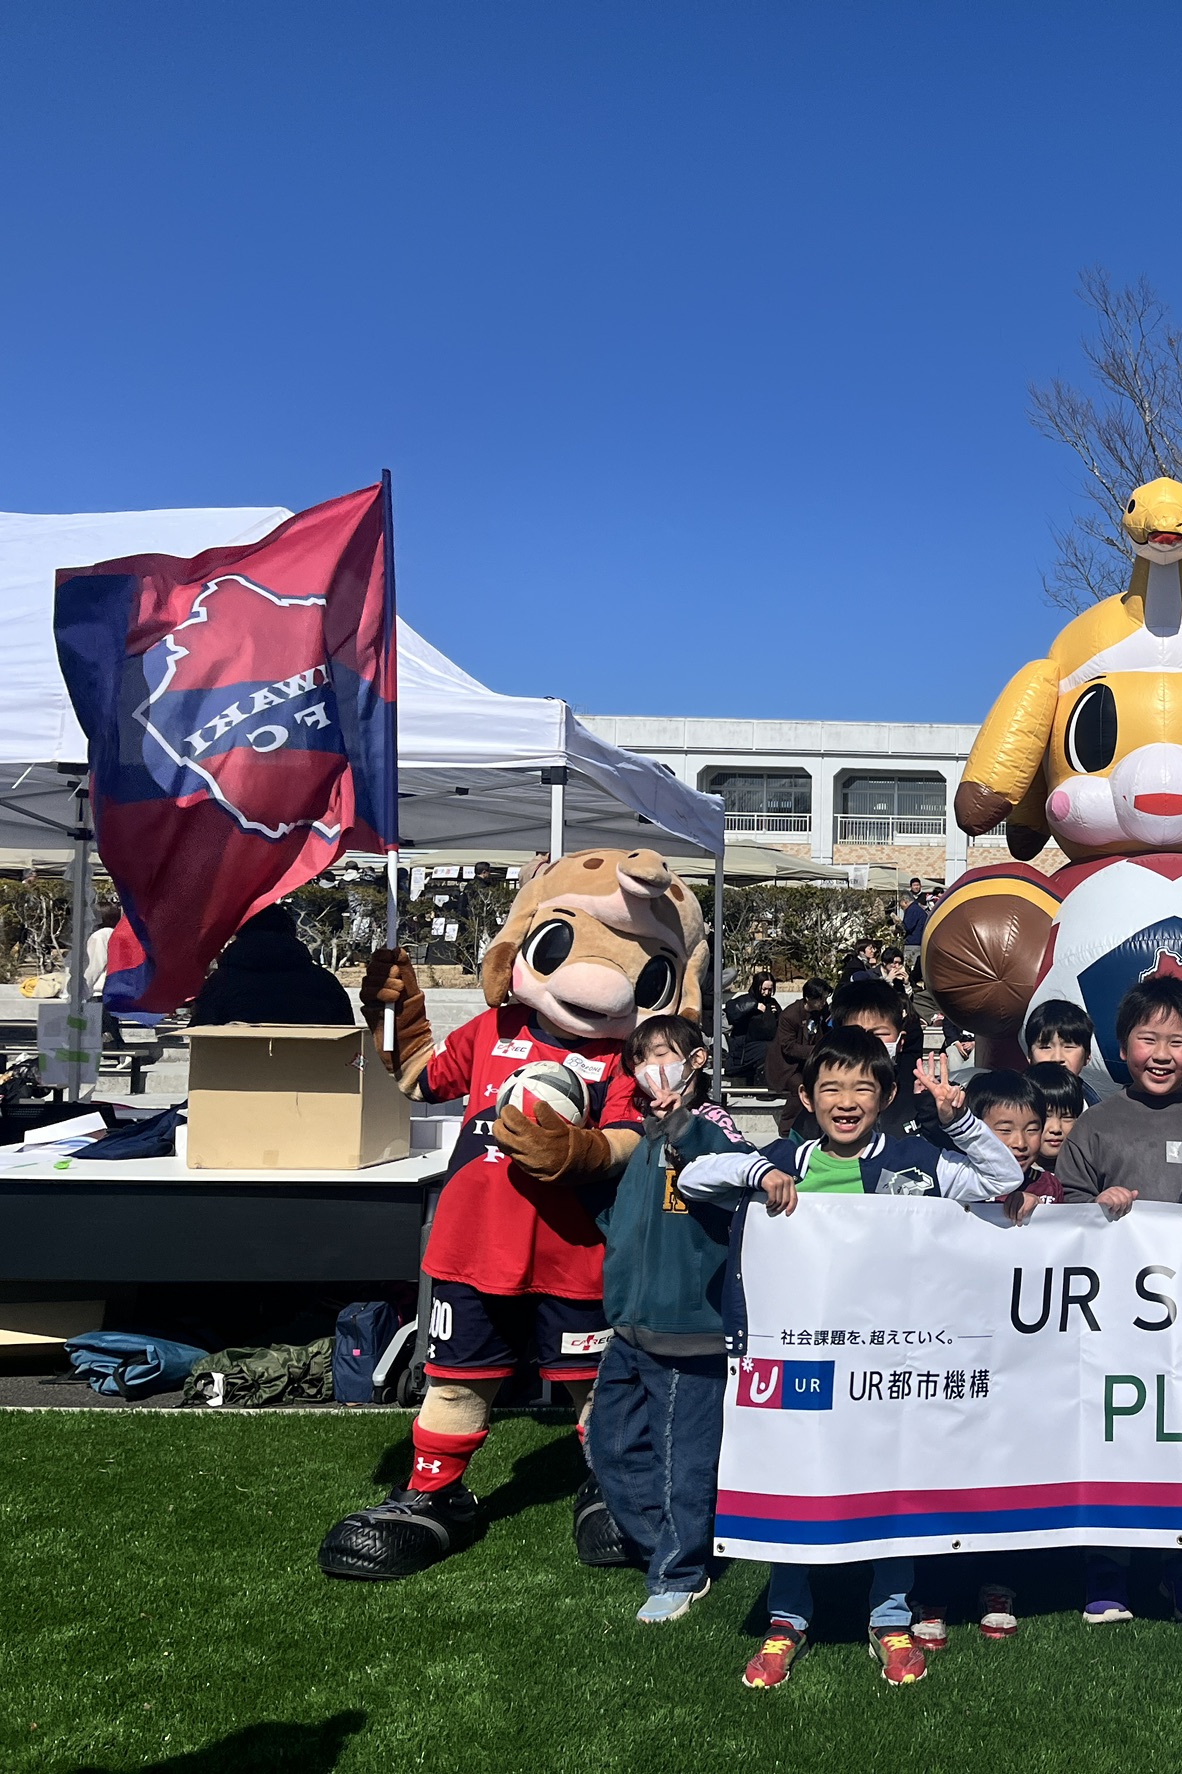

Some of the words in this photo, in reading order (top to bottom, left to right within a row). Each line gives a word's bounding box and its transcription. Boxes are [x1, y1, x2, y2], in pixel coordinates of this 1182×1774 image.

[1010, 1266, 1102, 1334] UR
[780, 1329, 954, 1346] 社会課題を、超えていく。
[795, 1378, 820, 1393] UR
[849, 1369, 990, 1401] UR都市機構
